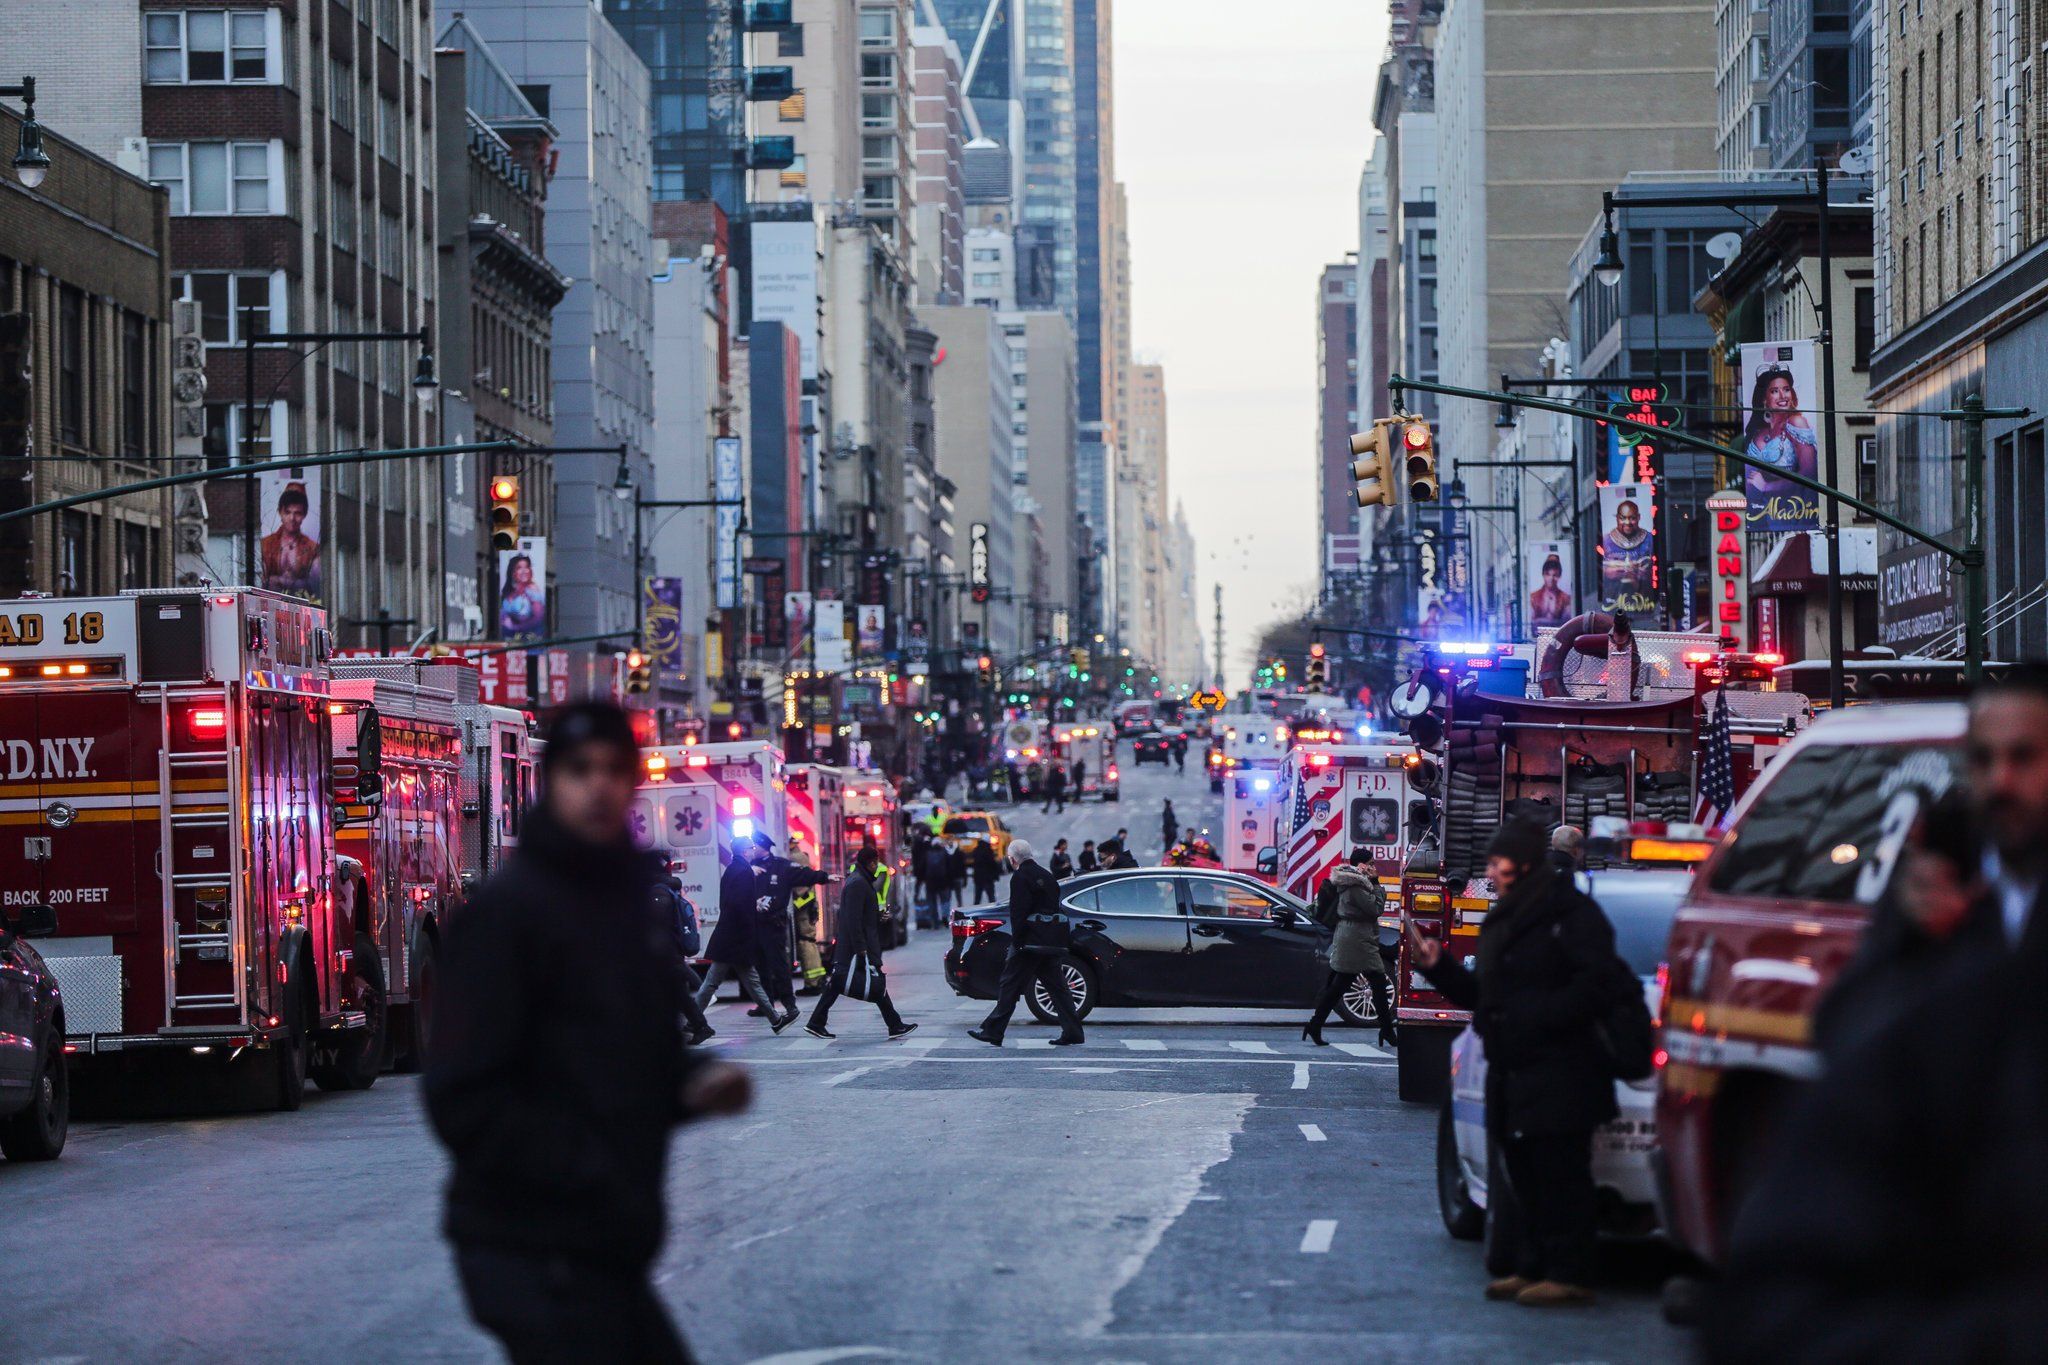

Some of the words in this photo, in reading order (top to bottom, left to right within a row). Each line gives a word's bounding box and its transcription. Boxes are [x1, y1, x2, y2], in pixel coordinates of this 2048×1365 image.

[1746, 496, 1819, 521] Aladdin
[1717, 512, 1741, 652] DANIEL
[63, 612, 104, 644] 18
[0, 738, 97, 780] .D.N.Y.
[1358, 774, 1391, 791] F.D.
[4, 890, 41, 905] BACK
[50, 889, 73, 903] 200
[76, 888, 109, 903] FEET
